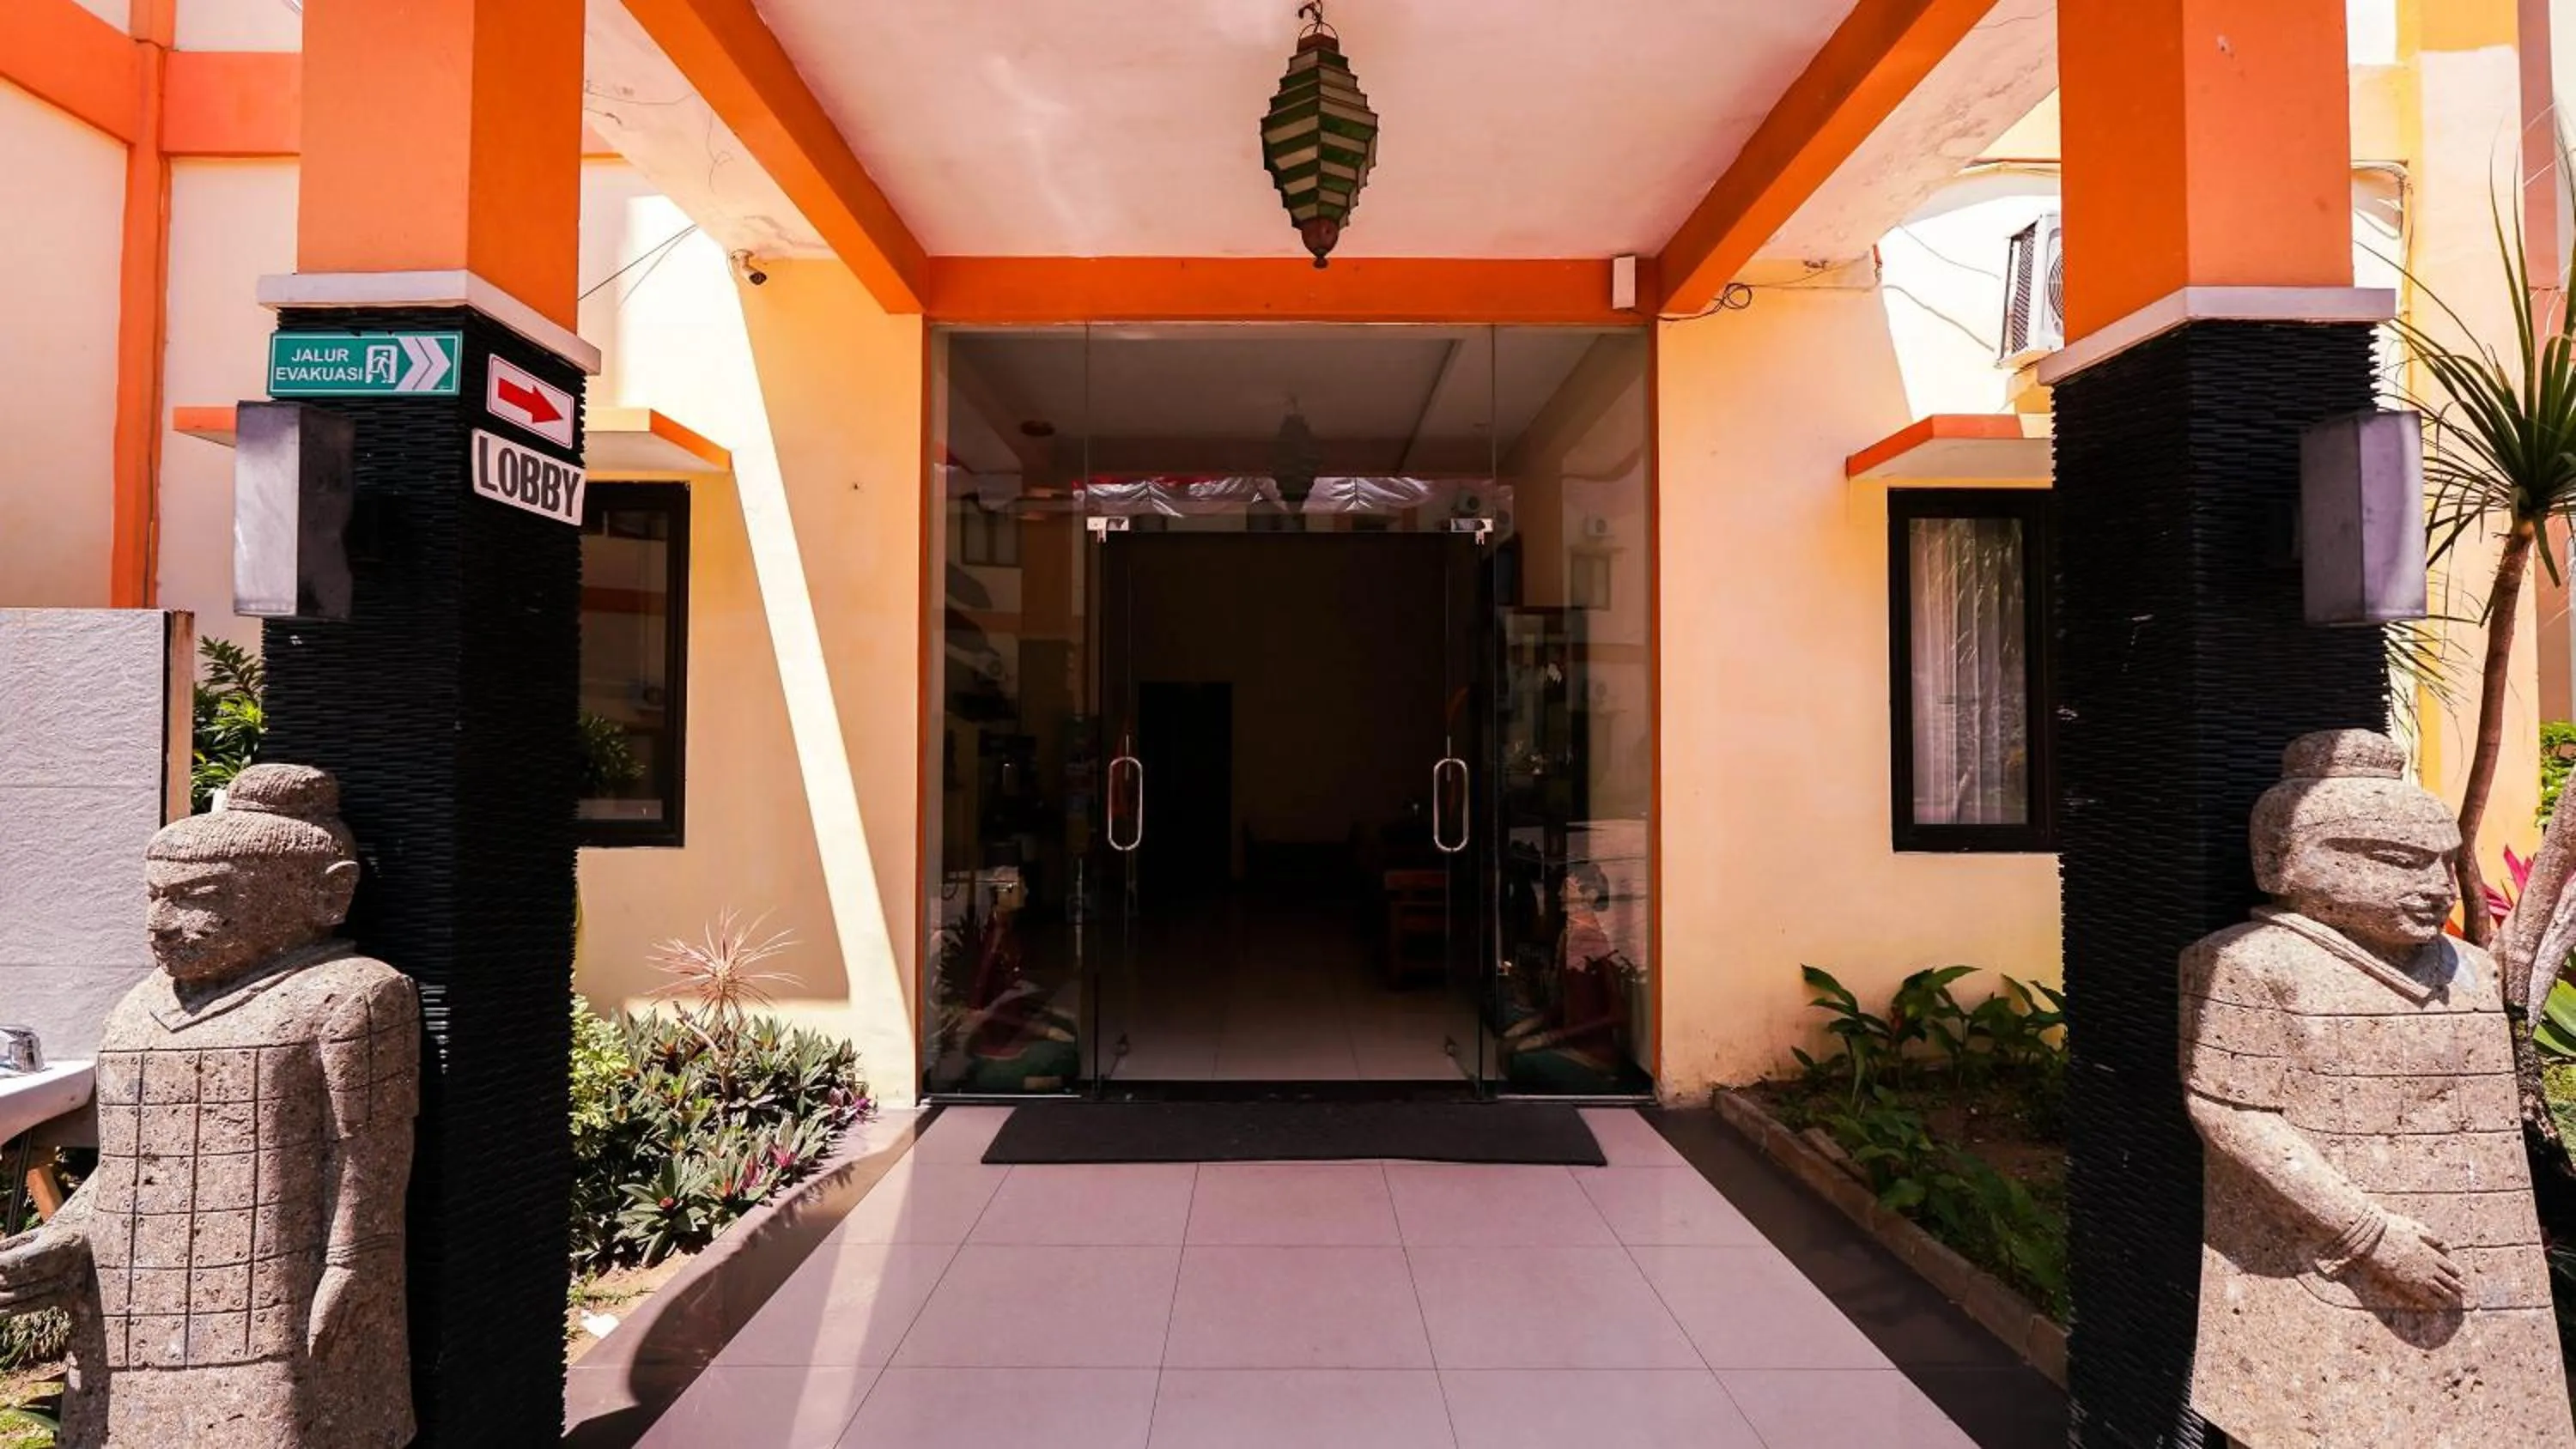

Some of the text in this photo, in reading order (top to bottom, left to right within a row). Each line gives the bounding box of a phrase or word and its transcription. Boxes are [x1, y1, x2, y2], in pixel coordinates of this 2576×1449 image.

[291, 349, 349, 362] JALUR
[276, 367, 363, 381] EVAKUASI
[478, 436, 581, 518] LOBBY
